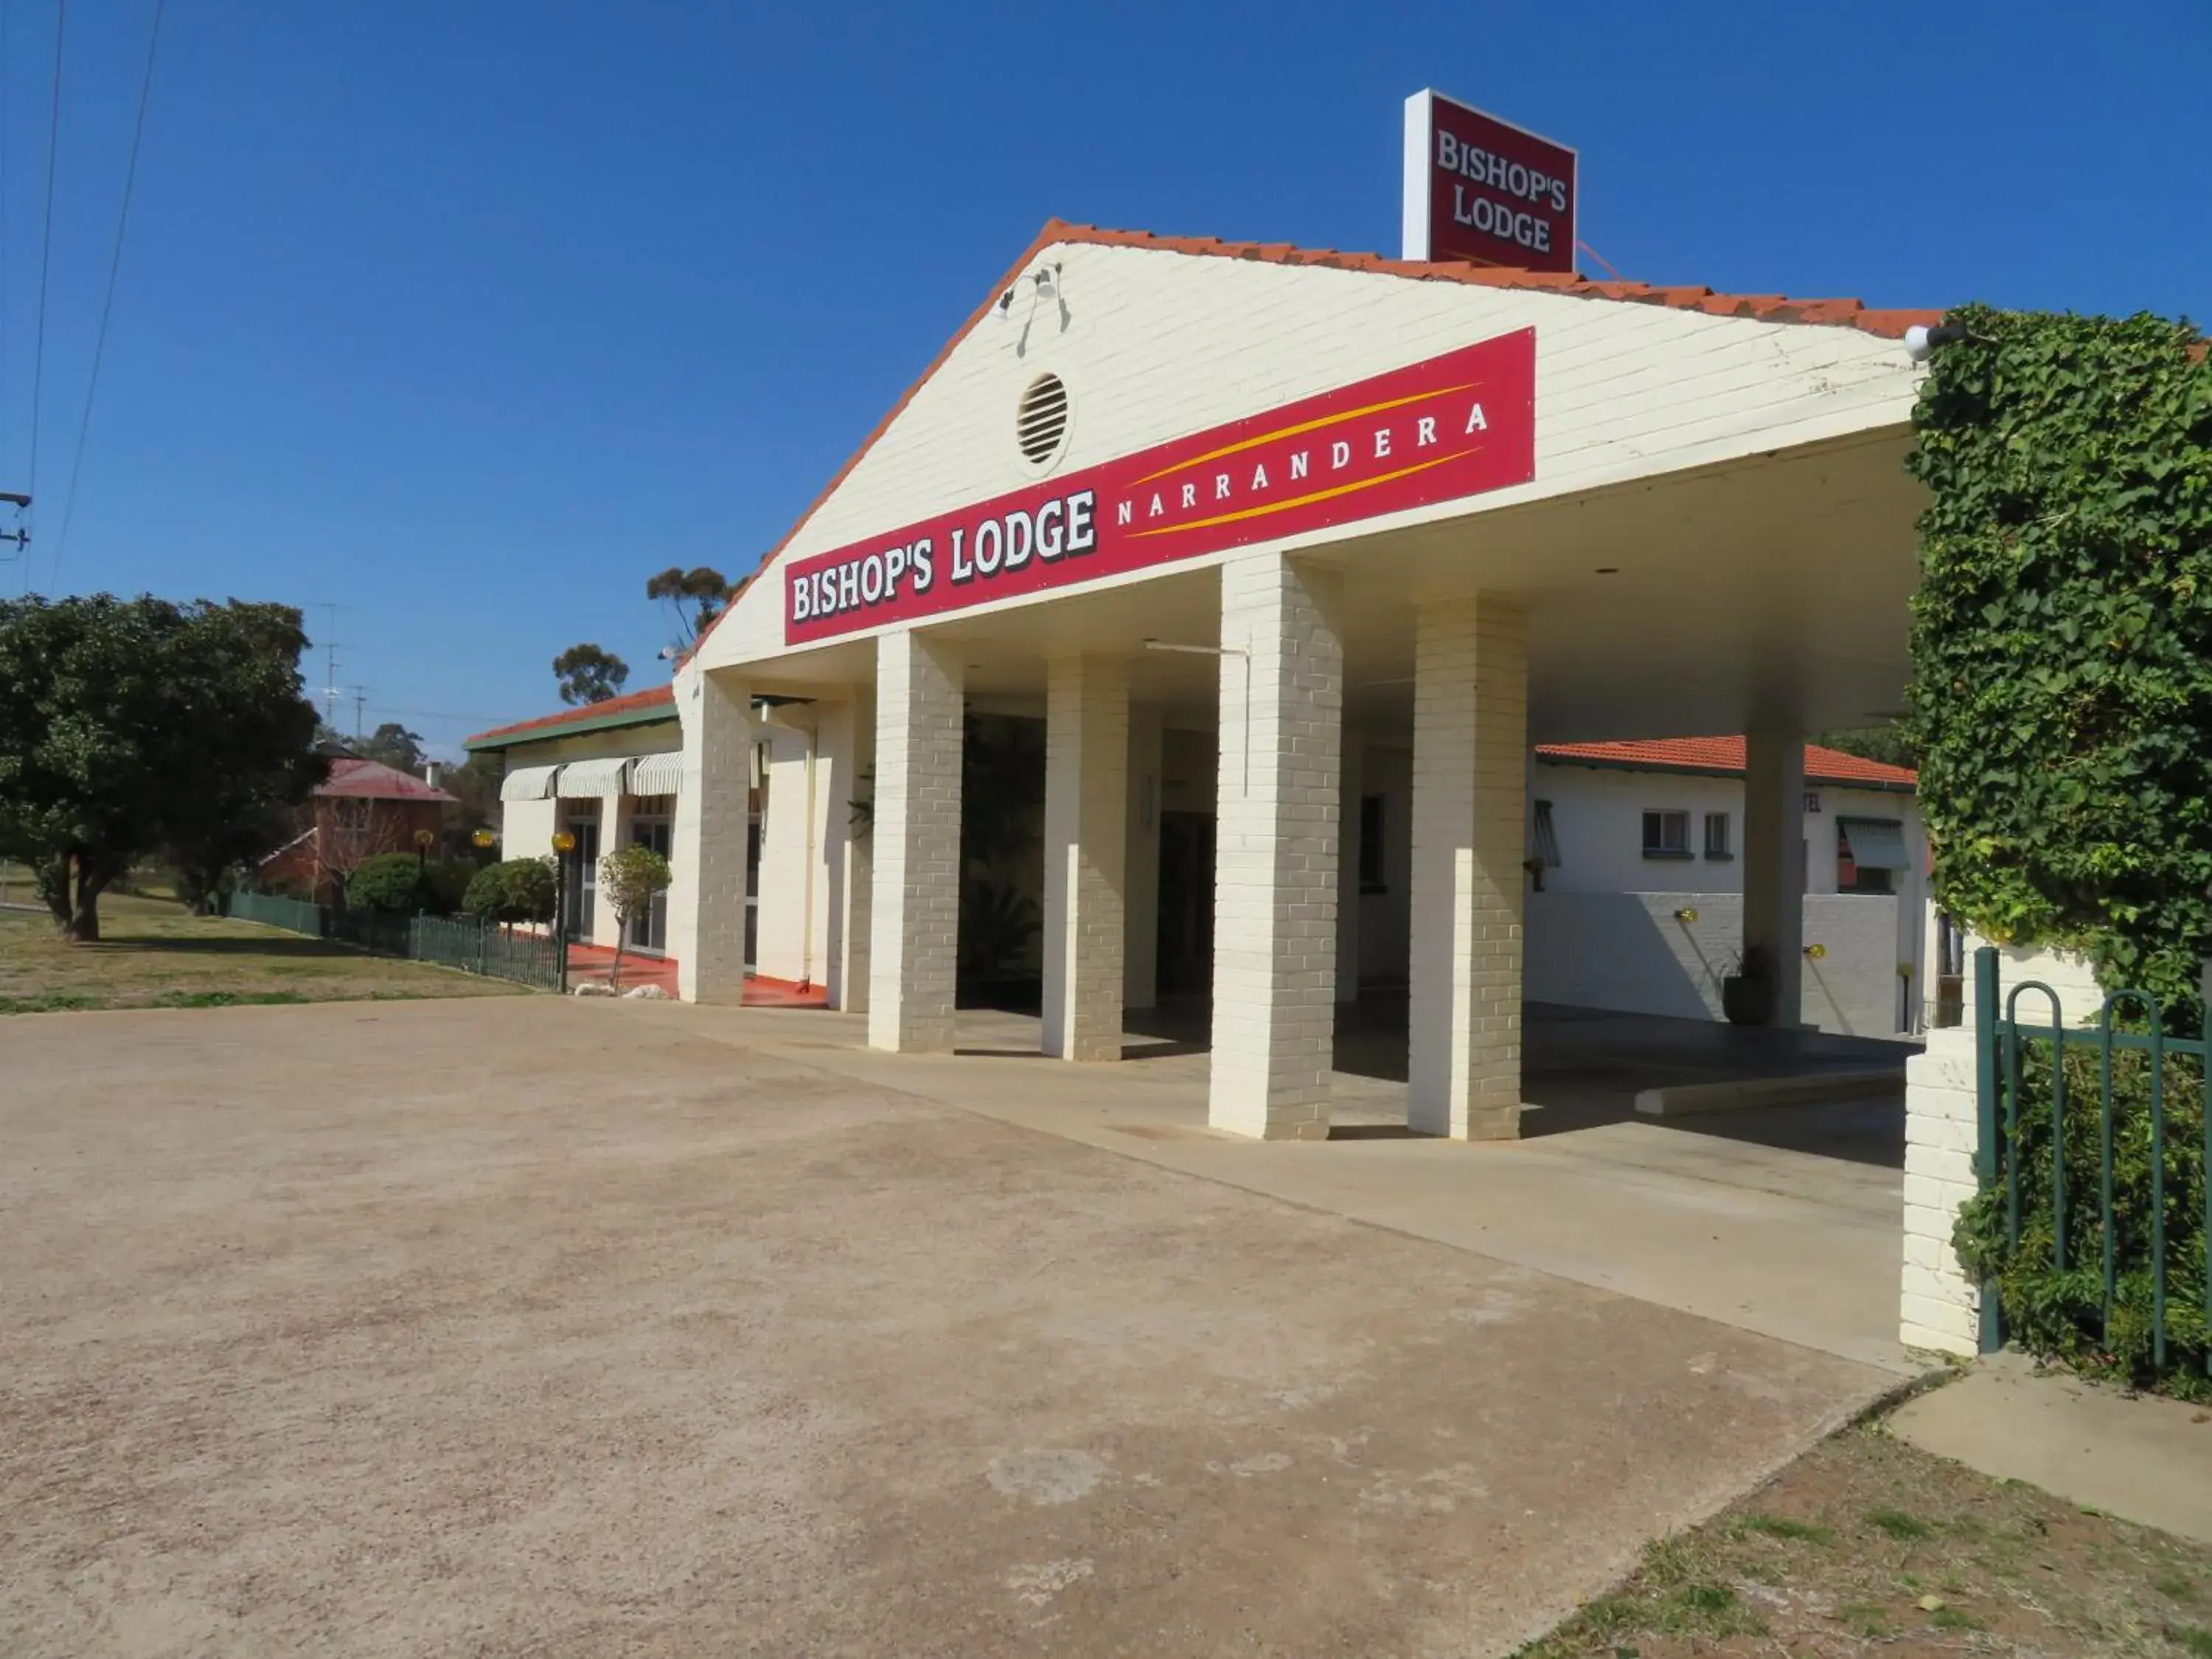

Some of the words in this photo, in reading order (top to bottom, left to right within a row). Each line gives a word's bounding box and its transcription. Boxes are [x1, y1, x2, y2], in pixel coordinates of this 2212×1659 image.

[1438, 129, 1566, 212] BISHOP'S
[1454, 184, 1549, 253] LODGE
[793, 539, 933, 620] BISHOP'S
[951, 490, 1095, 580] LODGE
[1118, 403, 1487, 525] NARRANDERA
